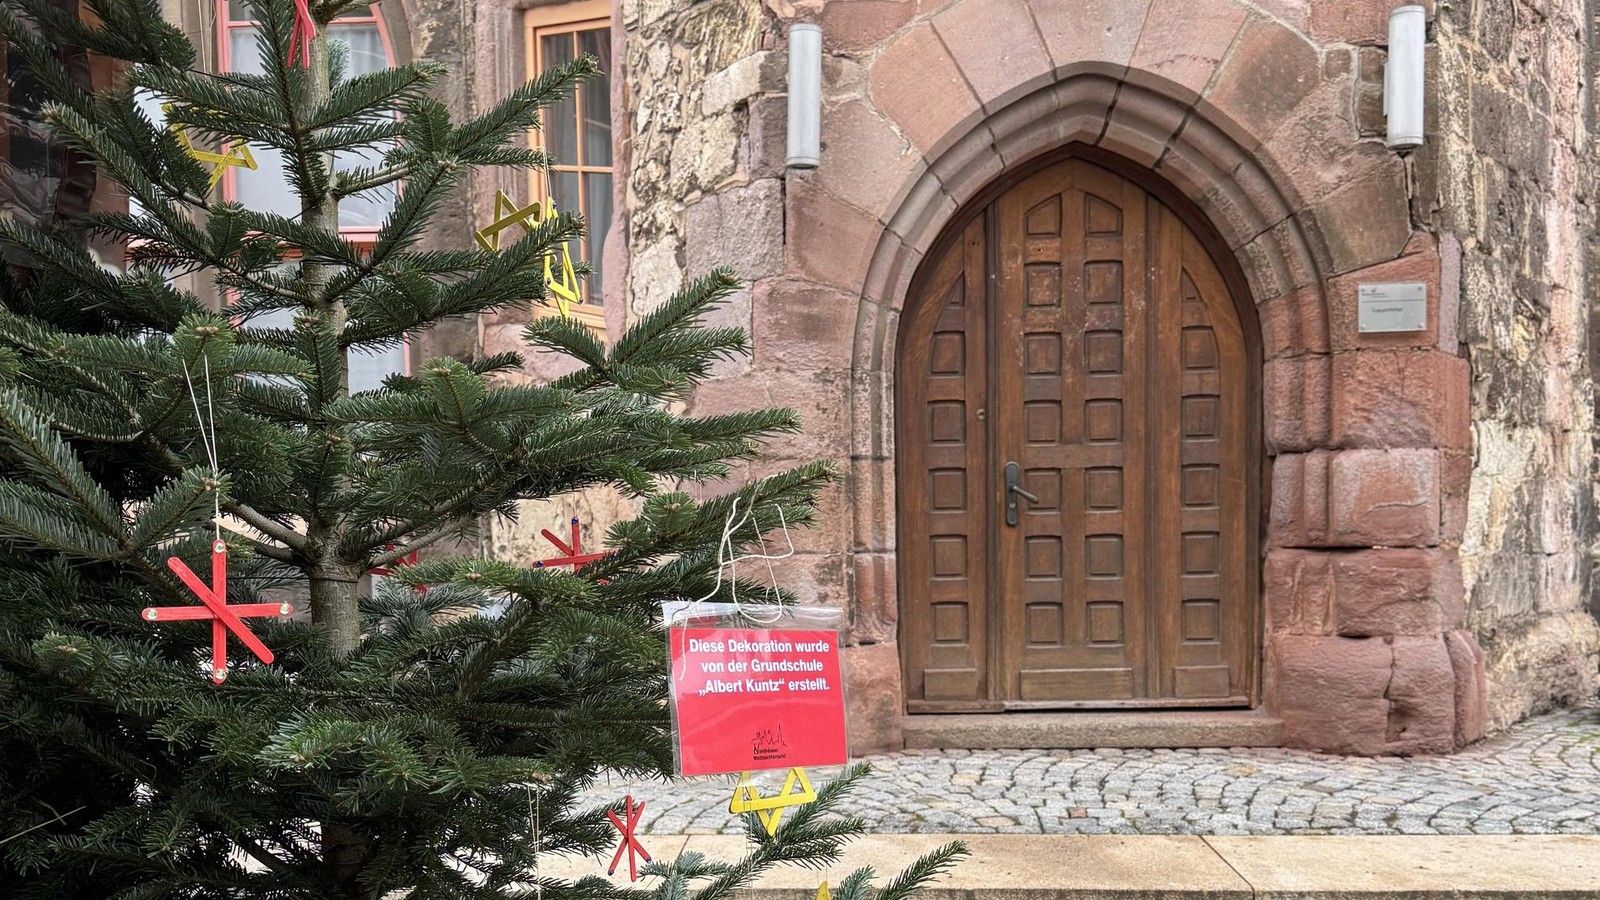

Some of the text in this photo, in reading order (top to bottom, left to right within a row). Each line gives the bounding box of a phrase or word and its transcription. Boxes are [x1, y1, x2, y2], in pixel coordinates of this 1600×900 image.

[689, 639, 830, 653] Diese Dekoration wurde
[701, 658, 823, 673] von der Grundschule
[698, 678, 830, 696] „Albert Kuntz“ erstellt.
